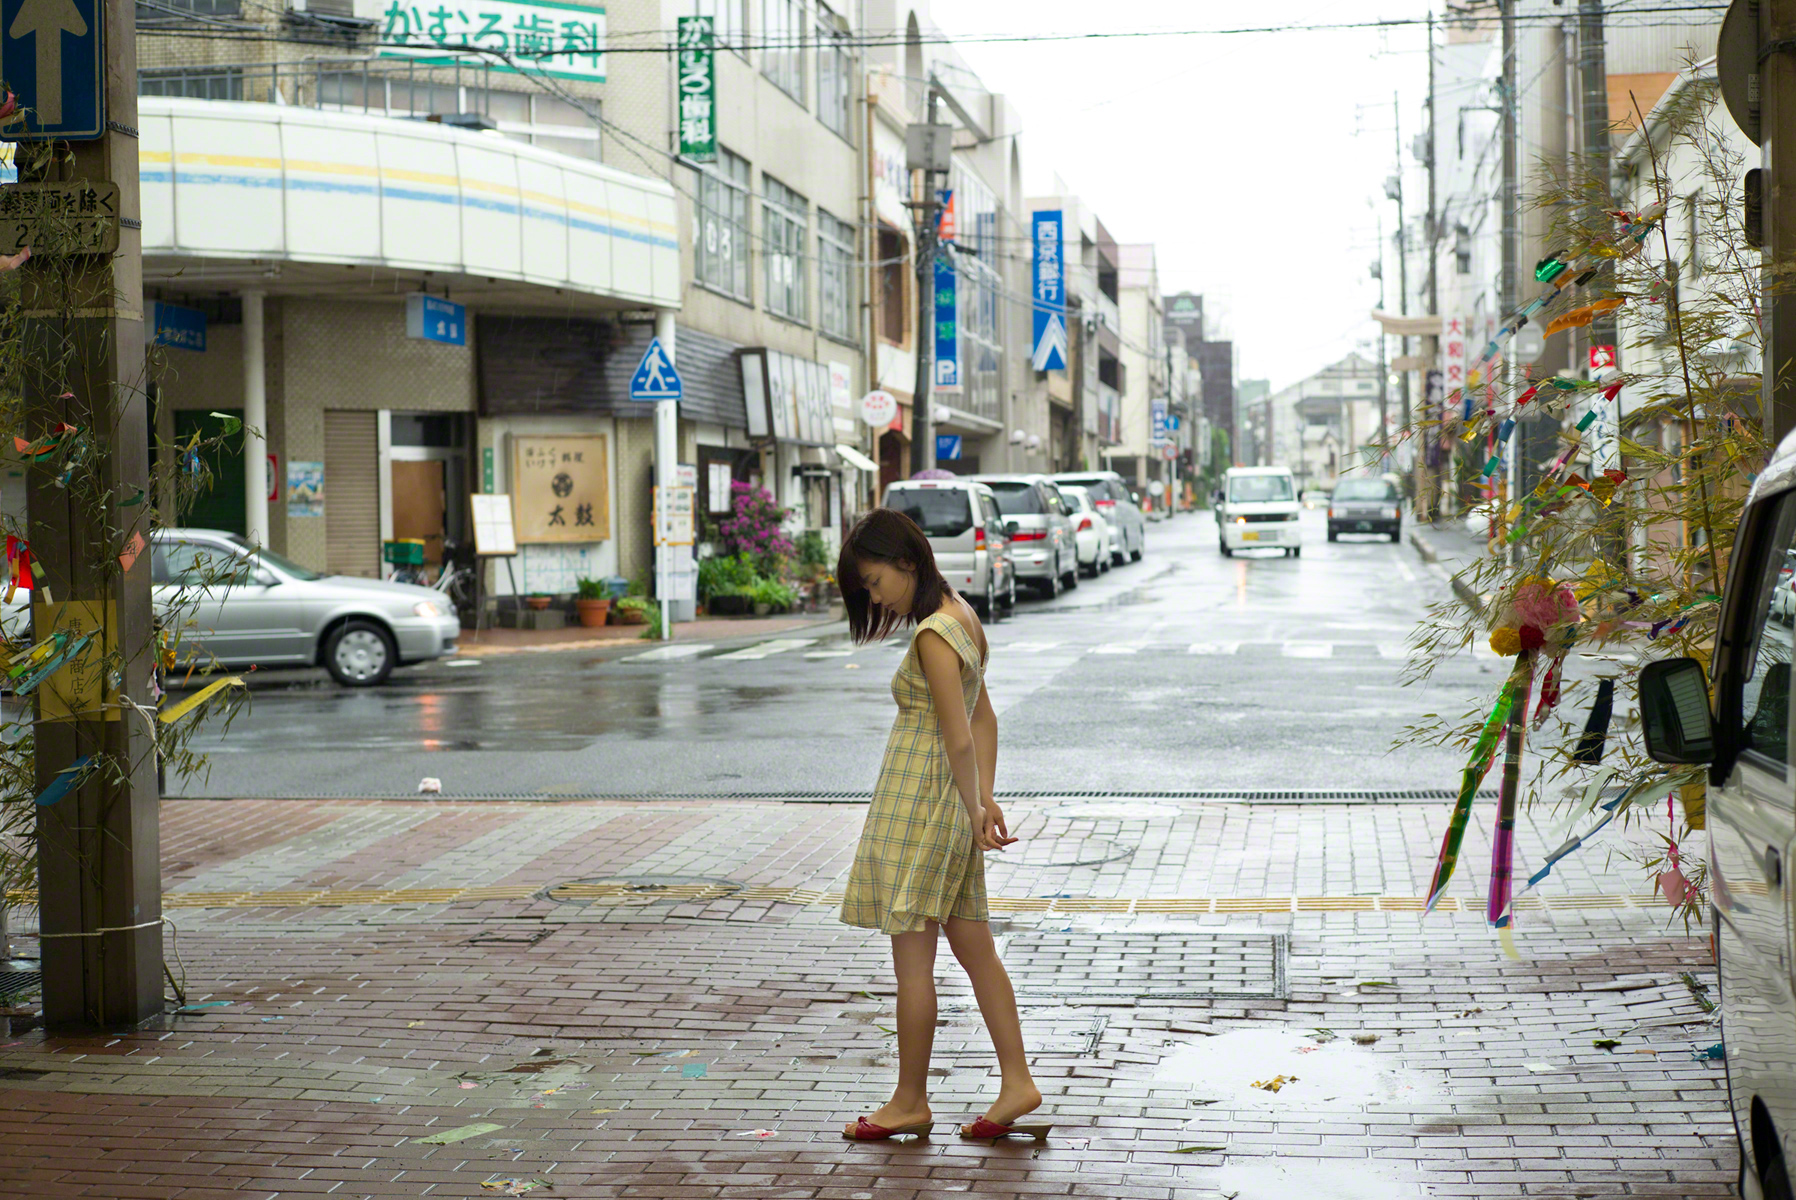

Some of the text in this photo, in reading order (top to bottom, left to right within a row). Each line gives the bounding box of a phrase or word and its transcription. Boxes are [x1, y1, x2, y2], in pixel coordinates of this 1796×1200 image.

[384, 1, 602, 69] かむろ歯科
[680, 17, 713, 145] かむろ歯科
[1037, 220, 1060, 301] 西京銀行
[547, 502, 595, 527] 太鼓
[69, 617, 89, 712] 唐商店会
